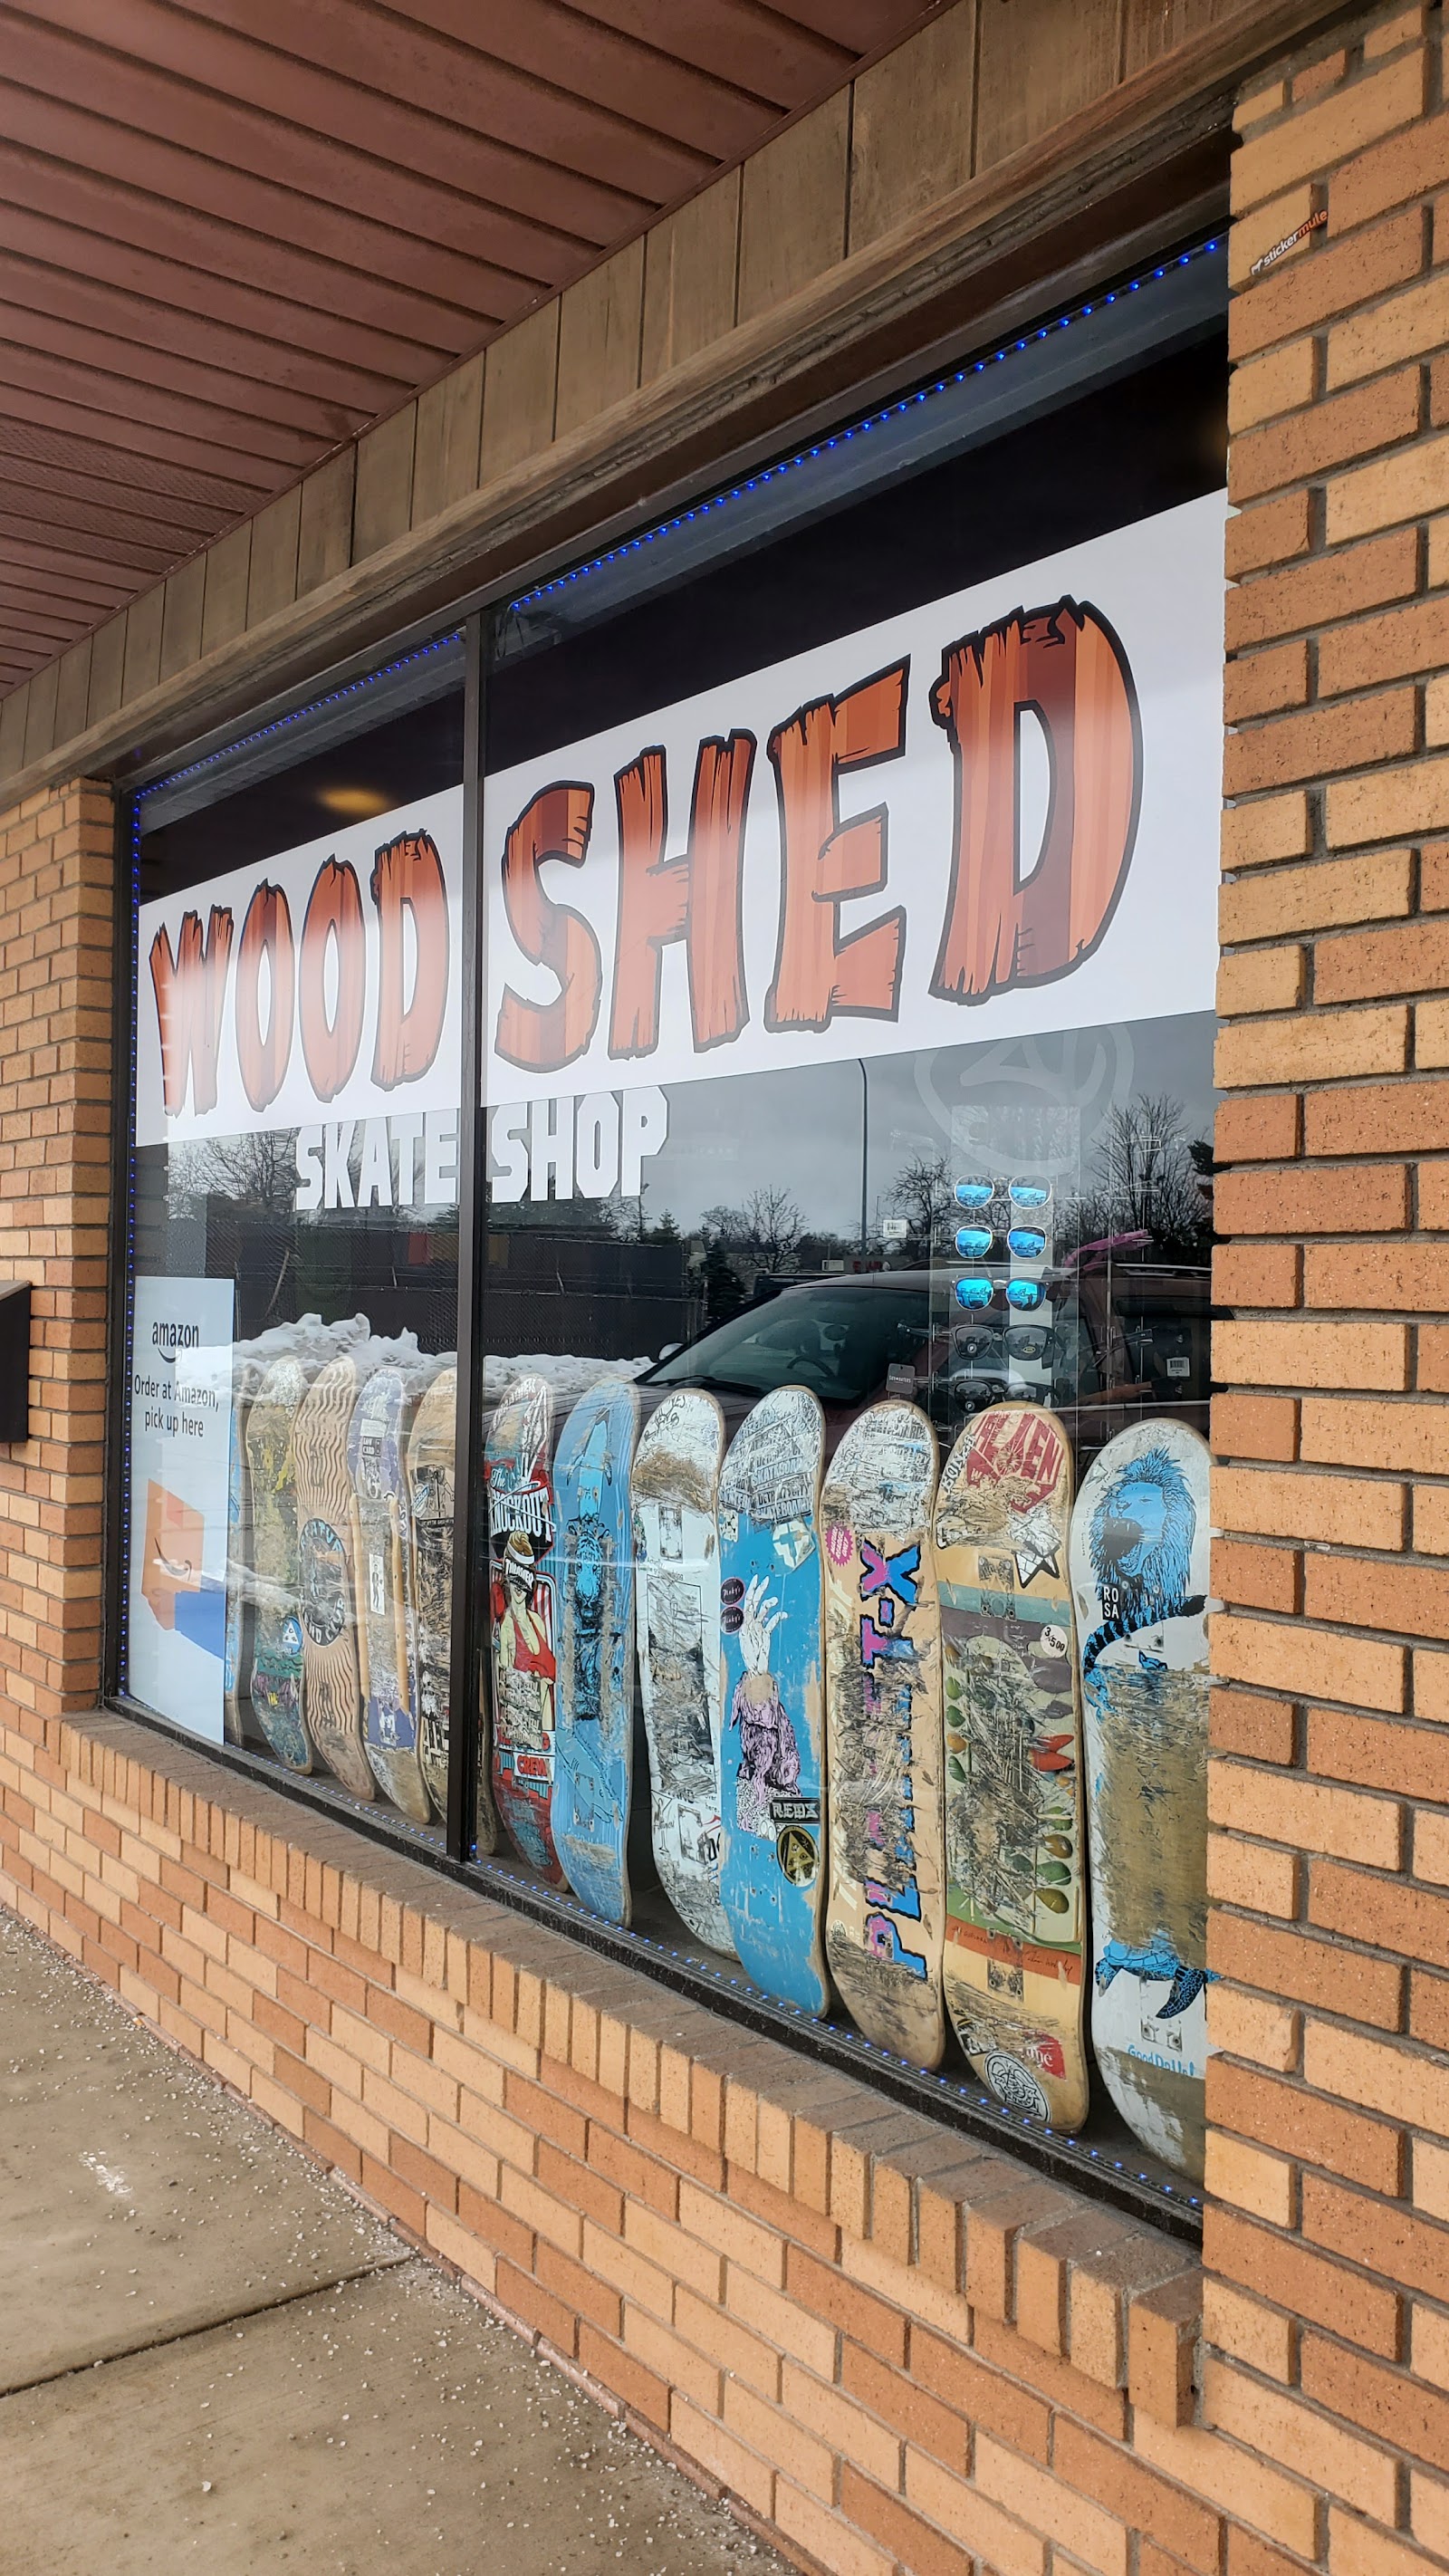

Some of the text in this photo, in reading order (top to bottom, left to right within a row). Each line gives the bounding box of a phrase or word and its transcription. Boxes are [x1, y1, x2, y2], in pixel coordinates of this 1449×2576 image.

[1263, 210, 1328, 266] stickermule
[149, 595, 1143, 1118] WOOD SHED
[295, 1086, 669, 1210] SKATE SHOP
[152, 1322, 199, 1348] amazon
[134, 1374, 219, 1412] Order at Amazon,
[145, 1406, 204, 1437] pick up here
[491, 1468, 505, 1486] The
[490, 1486, 552, 1543] KNOCKOUT
[1103, 1586, 1119, 1602] RO
[1104, 1602, 1119, 1620] SA
